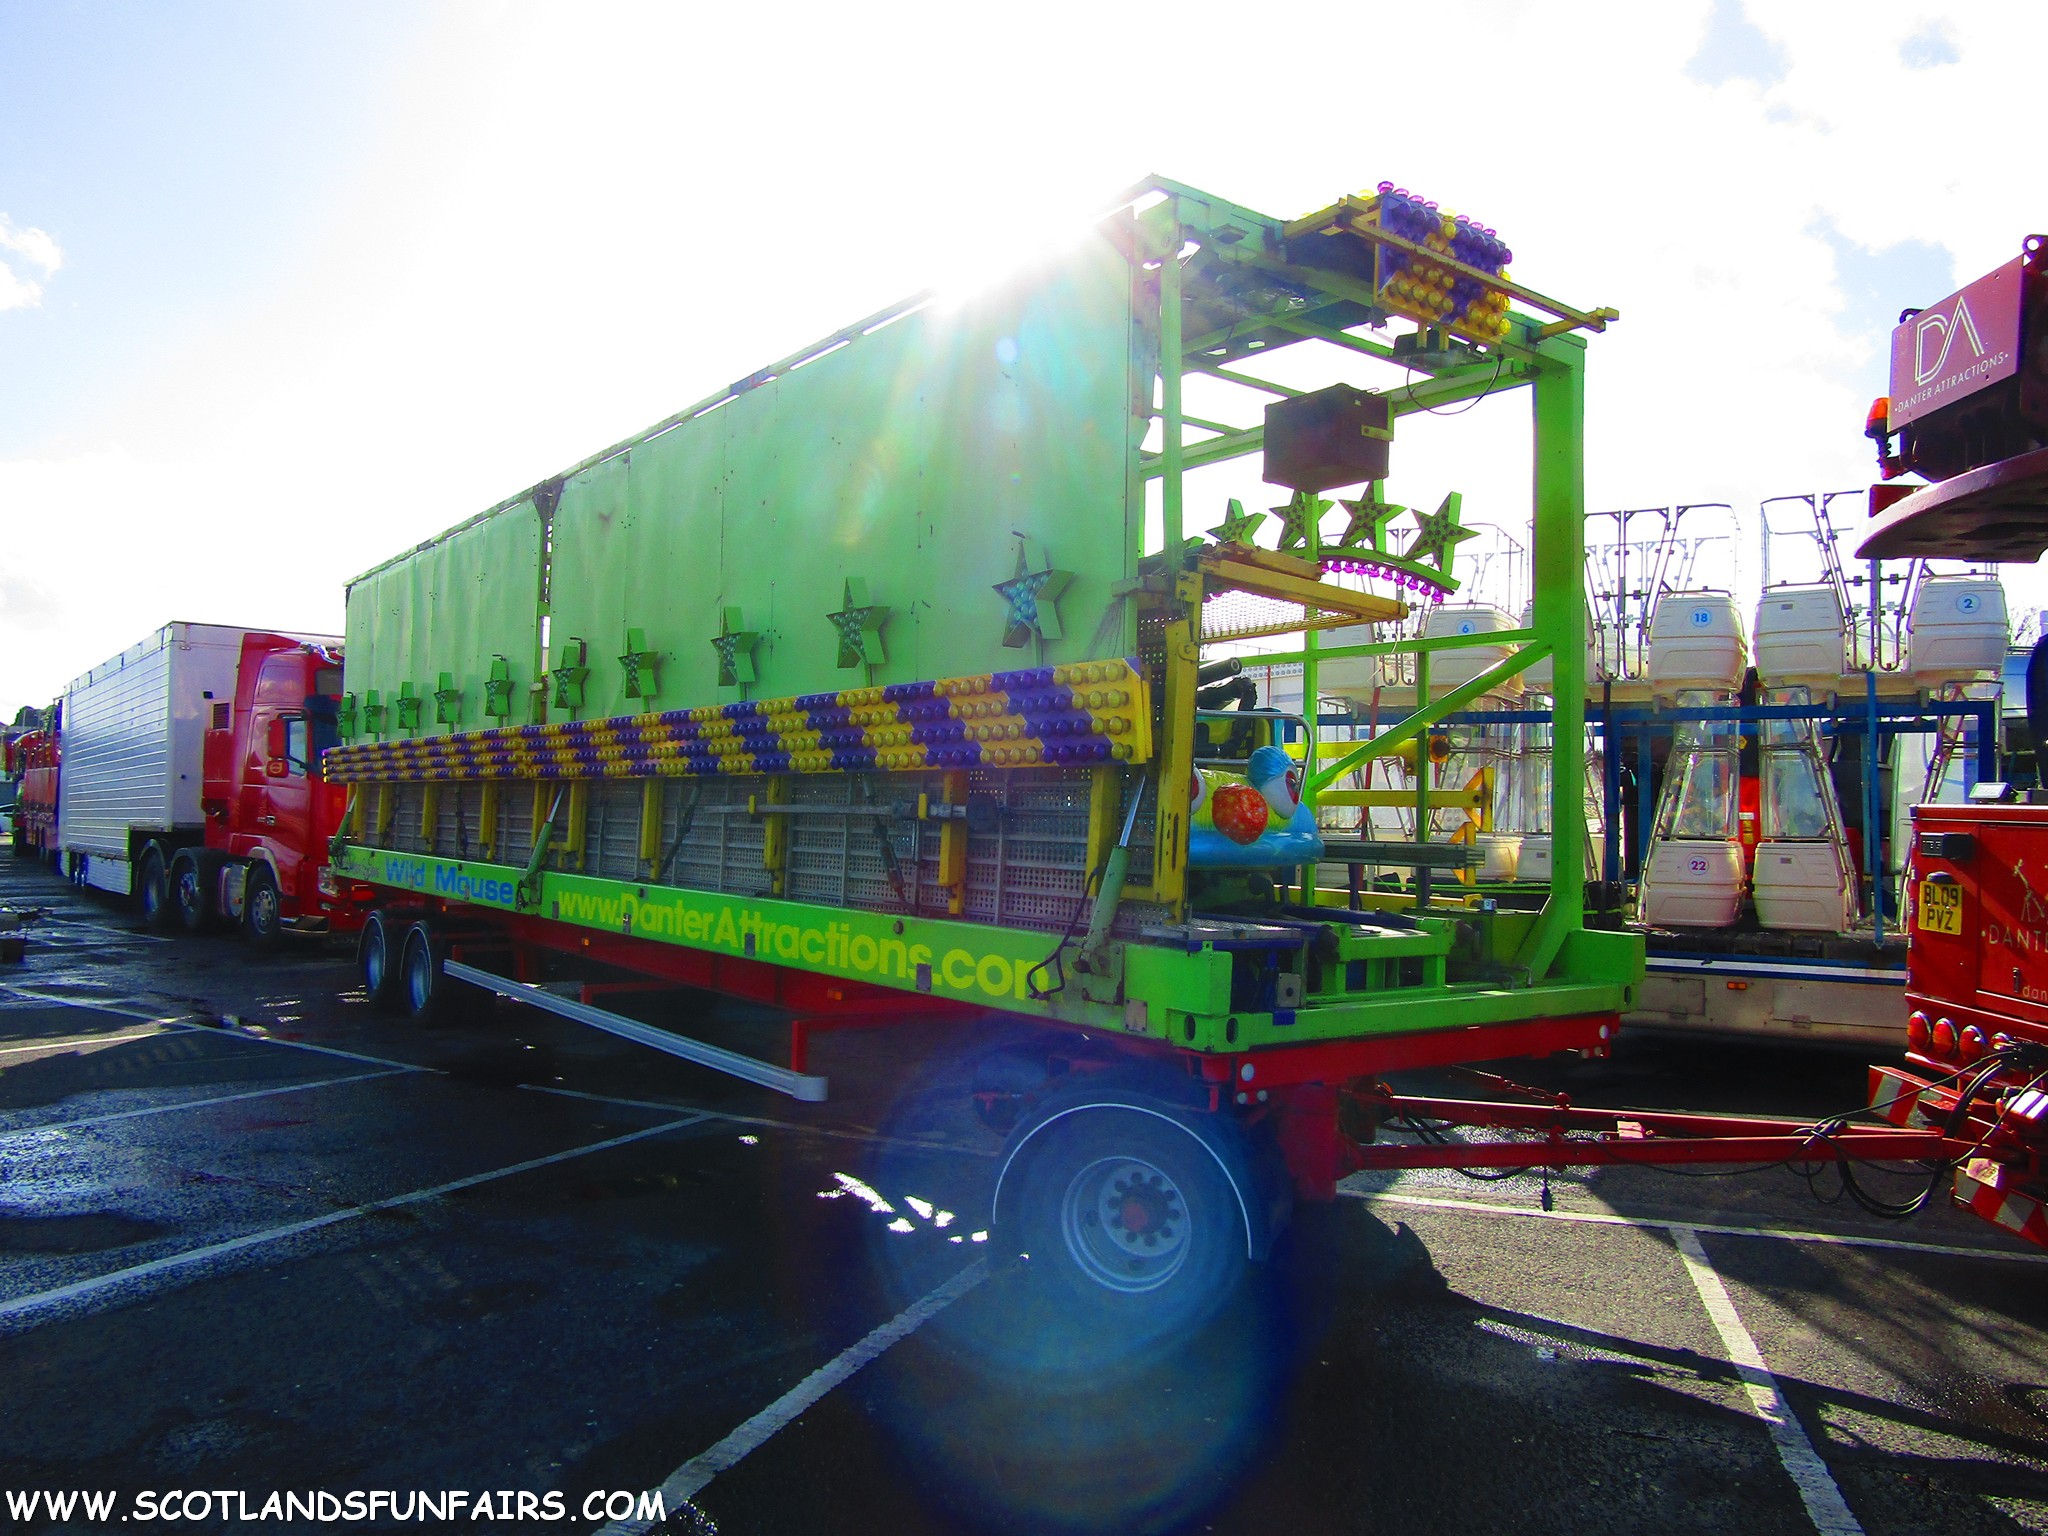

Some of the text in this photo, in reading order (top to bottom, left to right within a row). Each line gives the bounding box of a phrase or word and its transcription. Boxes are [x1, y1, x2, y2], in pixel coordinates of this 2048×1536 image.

[1897, 352, 2005, 413] DANTER ATTRACTIONS
[1963, 598, 1973, 609] 2
[1694, 613, 1708, 623] 18
[1462, 624, 1470, 634] 6
[1691, 860, 1706, 871] 22
[385, 857, 426, 888] Wild
[434, 864, 514, 905] Mouse
[1923, 884, 1959, 908] BL09
[1926, 908, 1954, 931] PVZ
